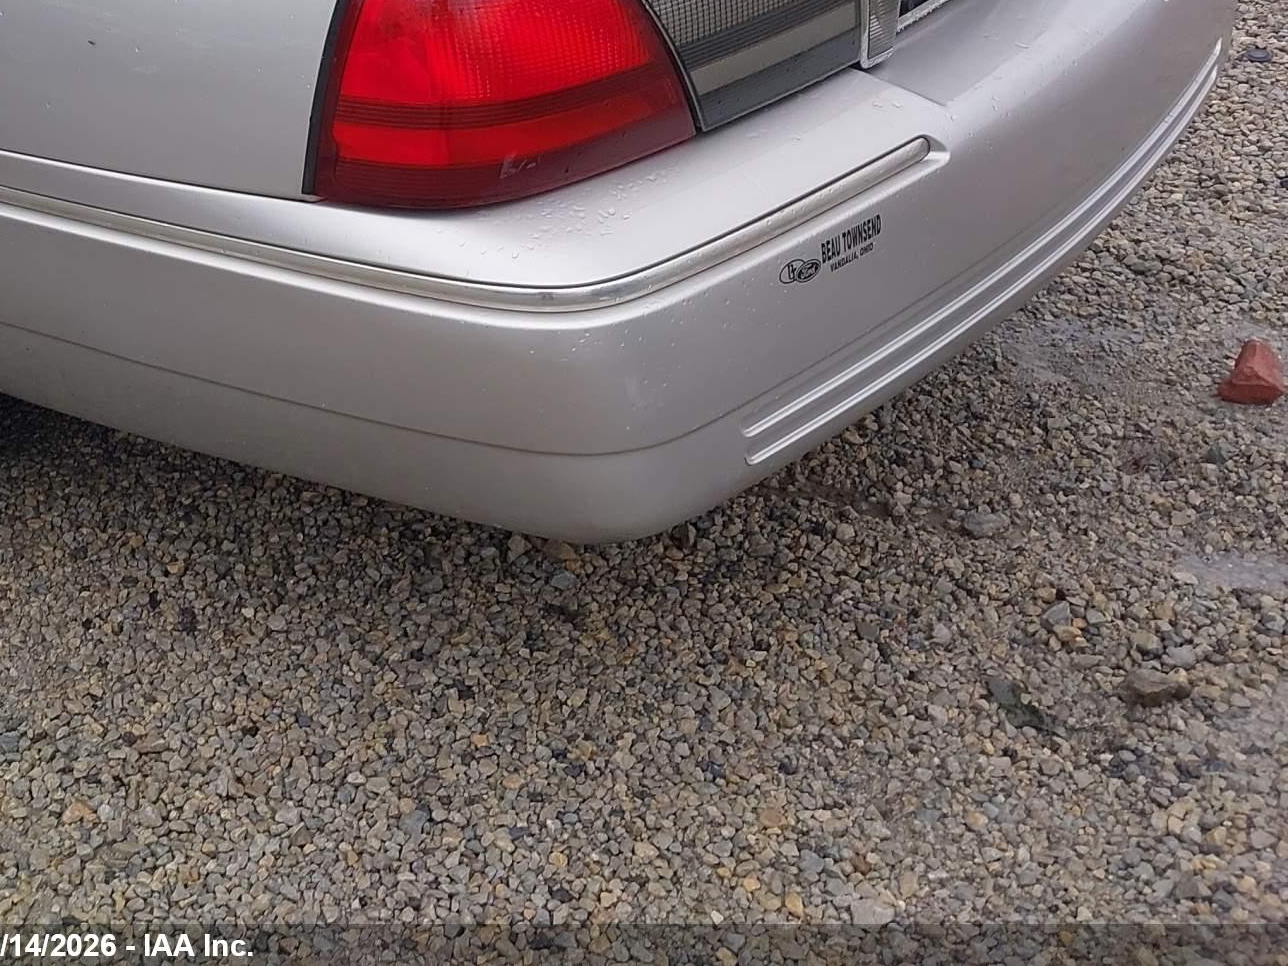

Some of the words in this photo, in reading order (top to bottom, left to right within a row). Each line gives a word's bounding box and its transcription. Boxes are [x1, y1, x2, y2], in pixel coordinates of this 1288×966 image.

[821, 235, 841, 264] BEAU
[842, 214, 882, 253] TOWNSEND
[860, 242, 874, 256] OHIO
